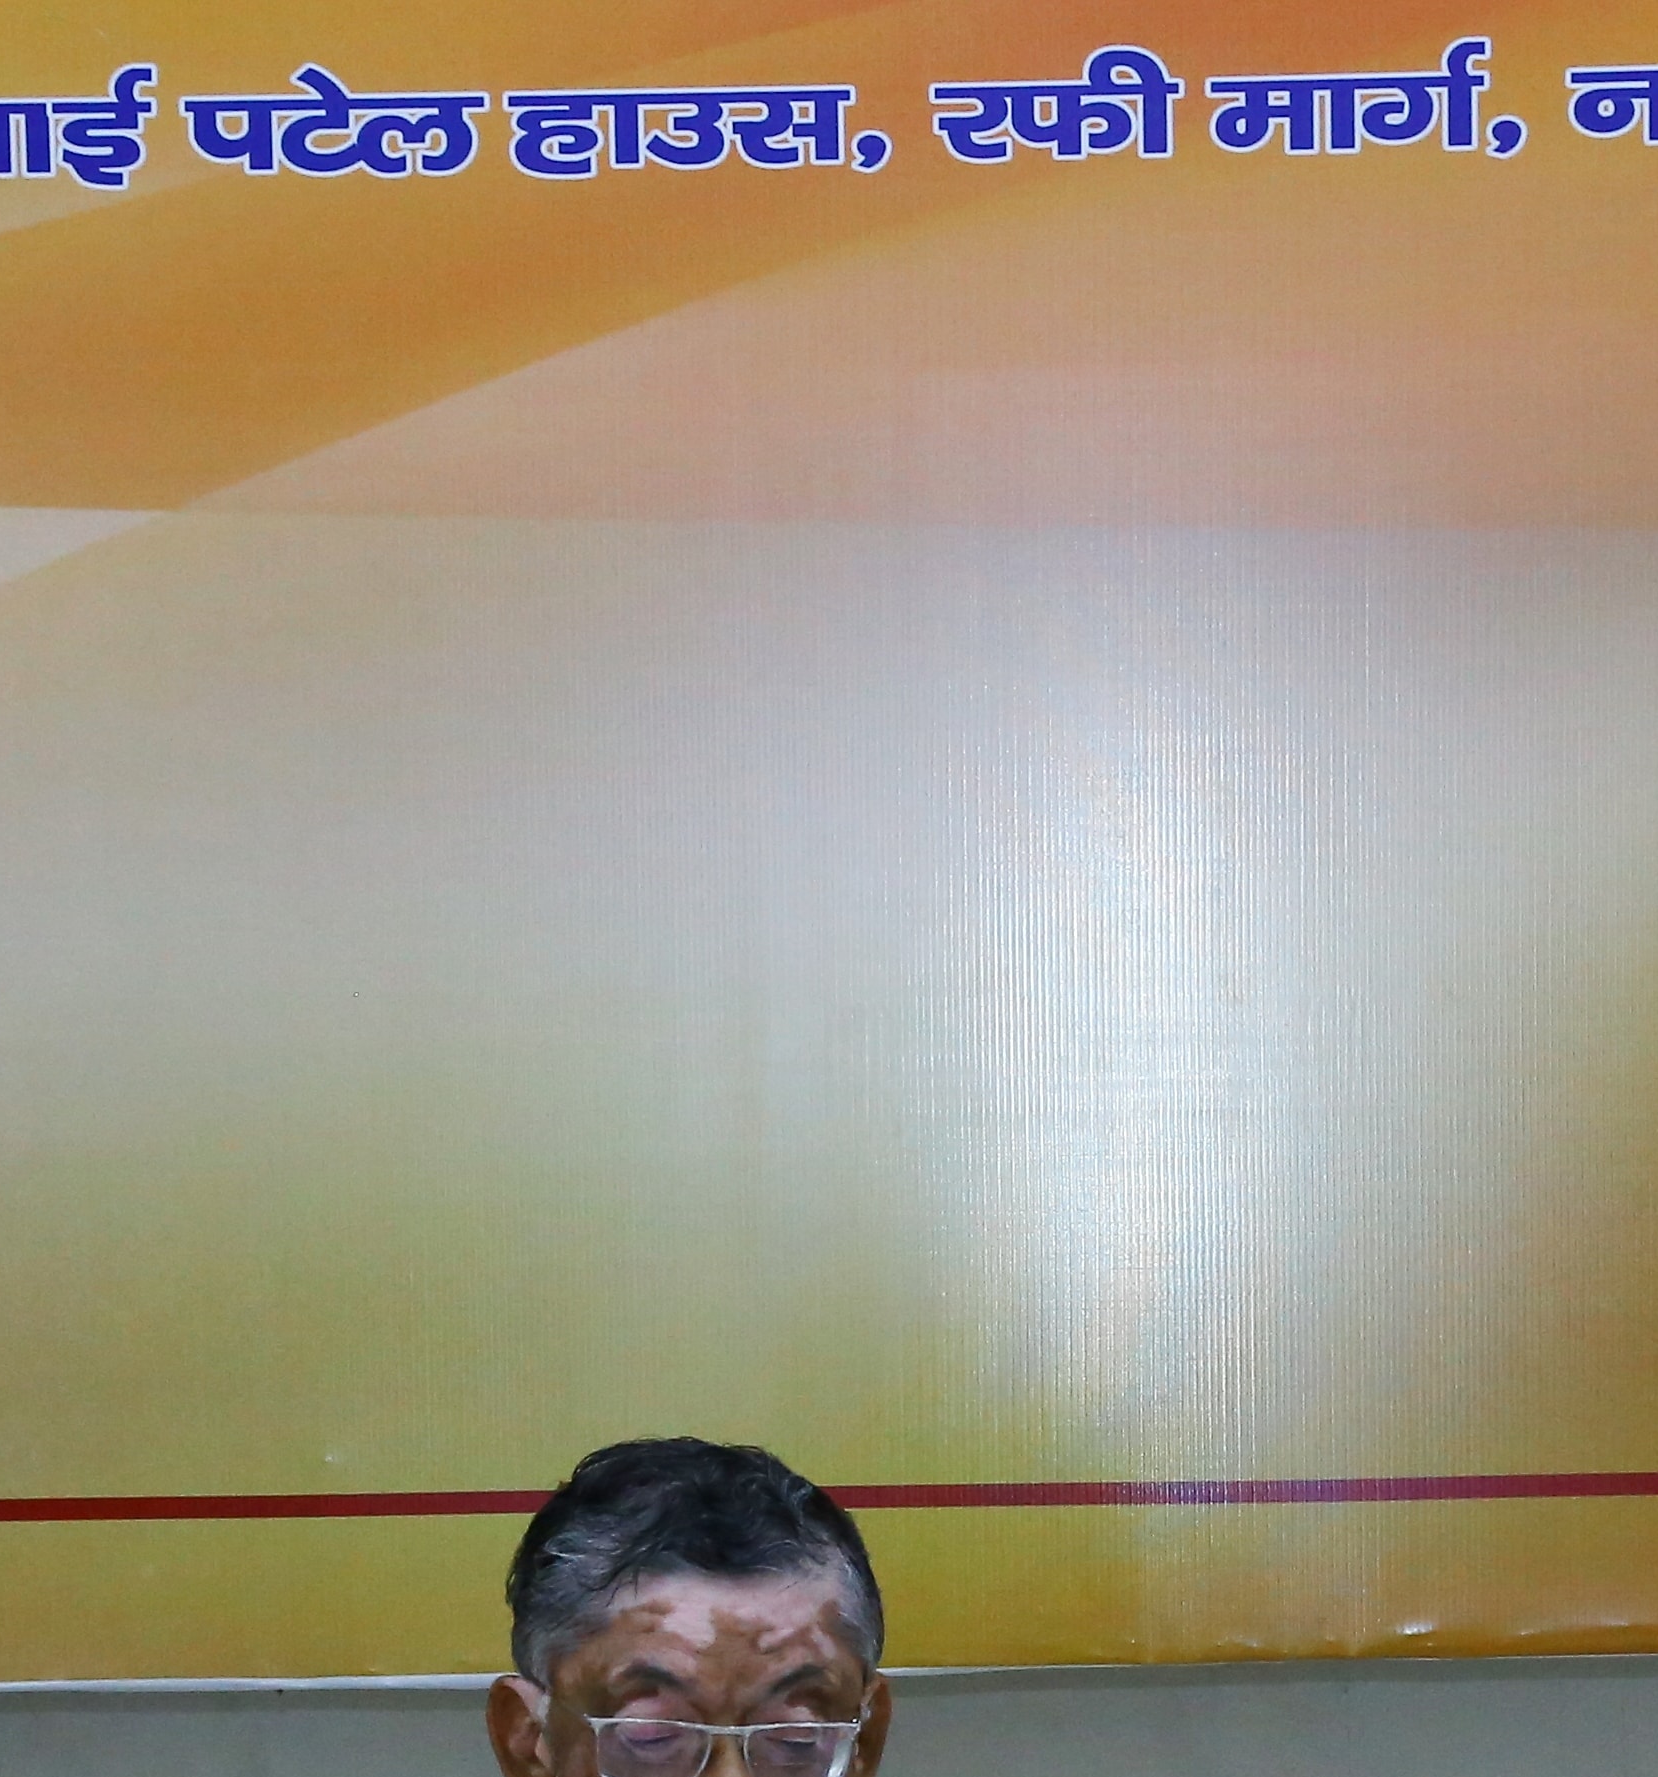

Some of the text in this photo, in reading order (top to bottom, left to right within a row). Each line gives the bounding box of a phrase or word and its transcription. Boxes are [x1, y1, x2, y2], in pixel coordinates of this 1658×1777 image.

[180, 66, 487, 177] पटेल
[506, 84, 893, 179] हाउस,
[930, 45, 1183, 163] रफी
[1207, 37, 1527, 158] मार्ग,
